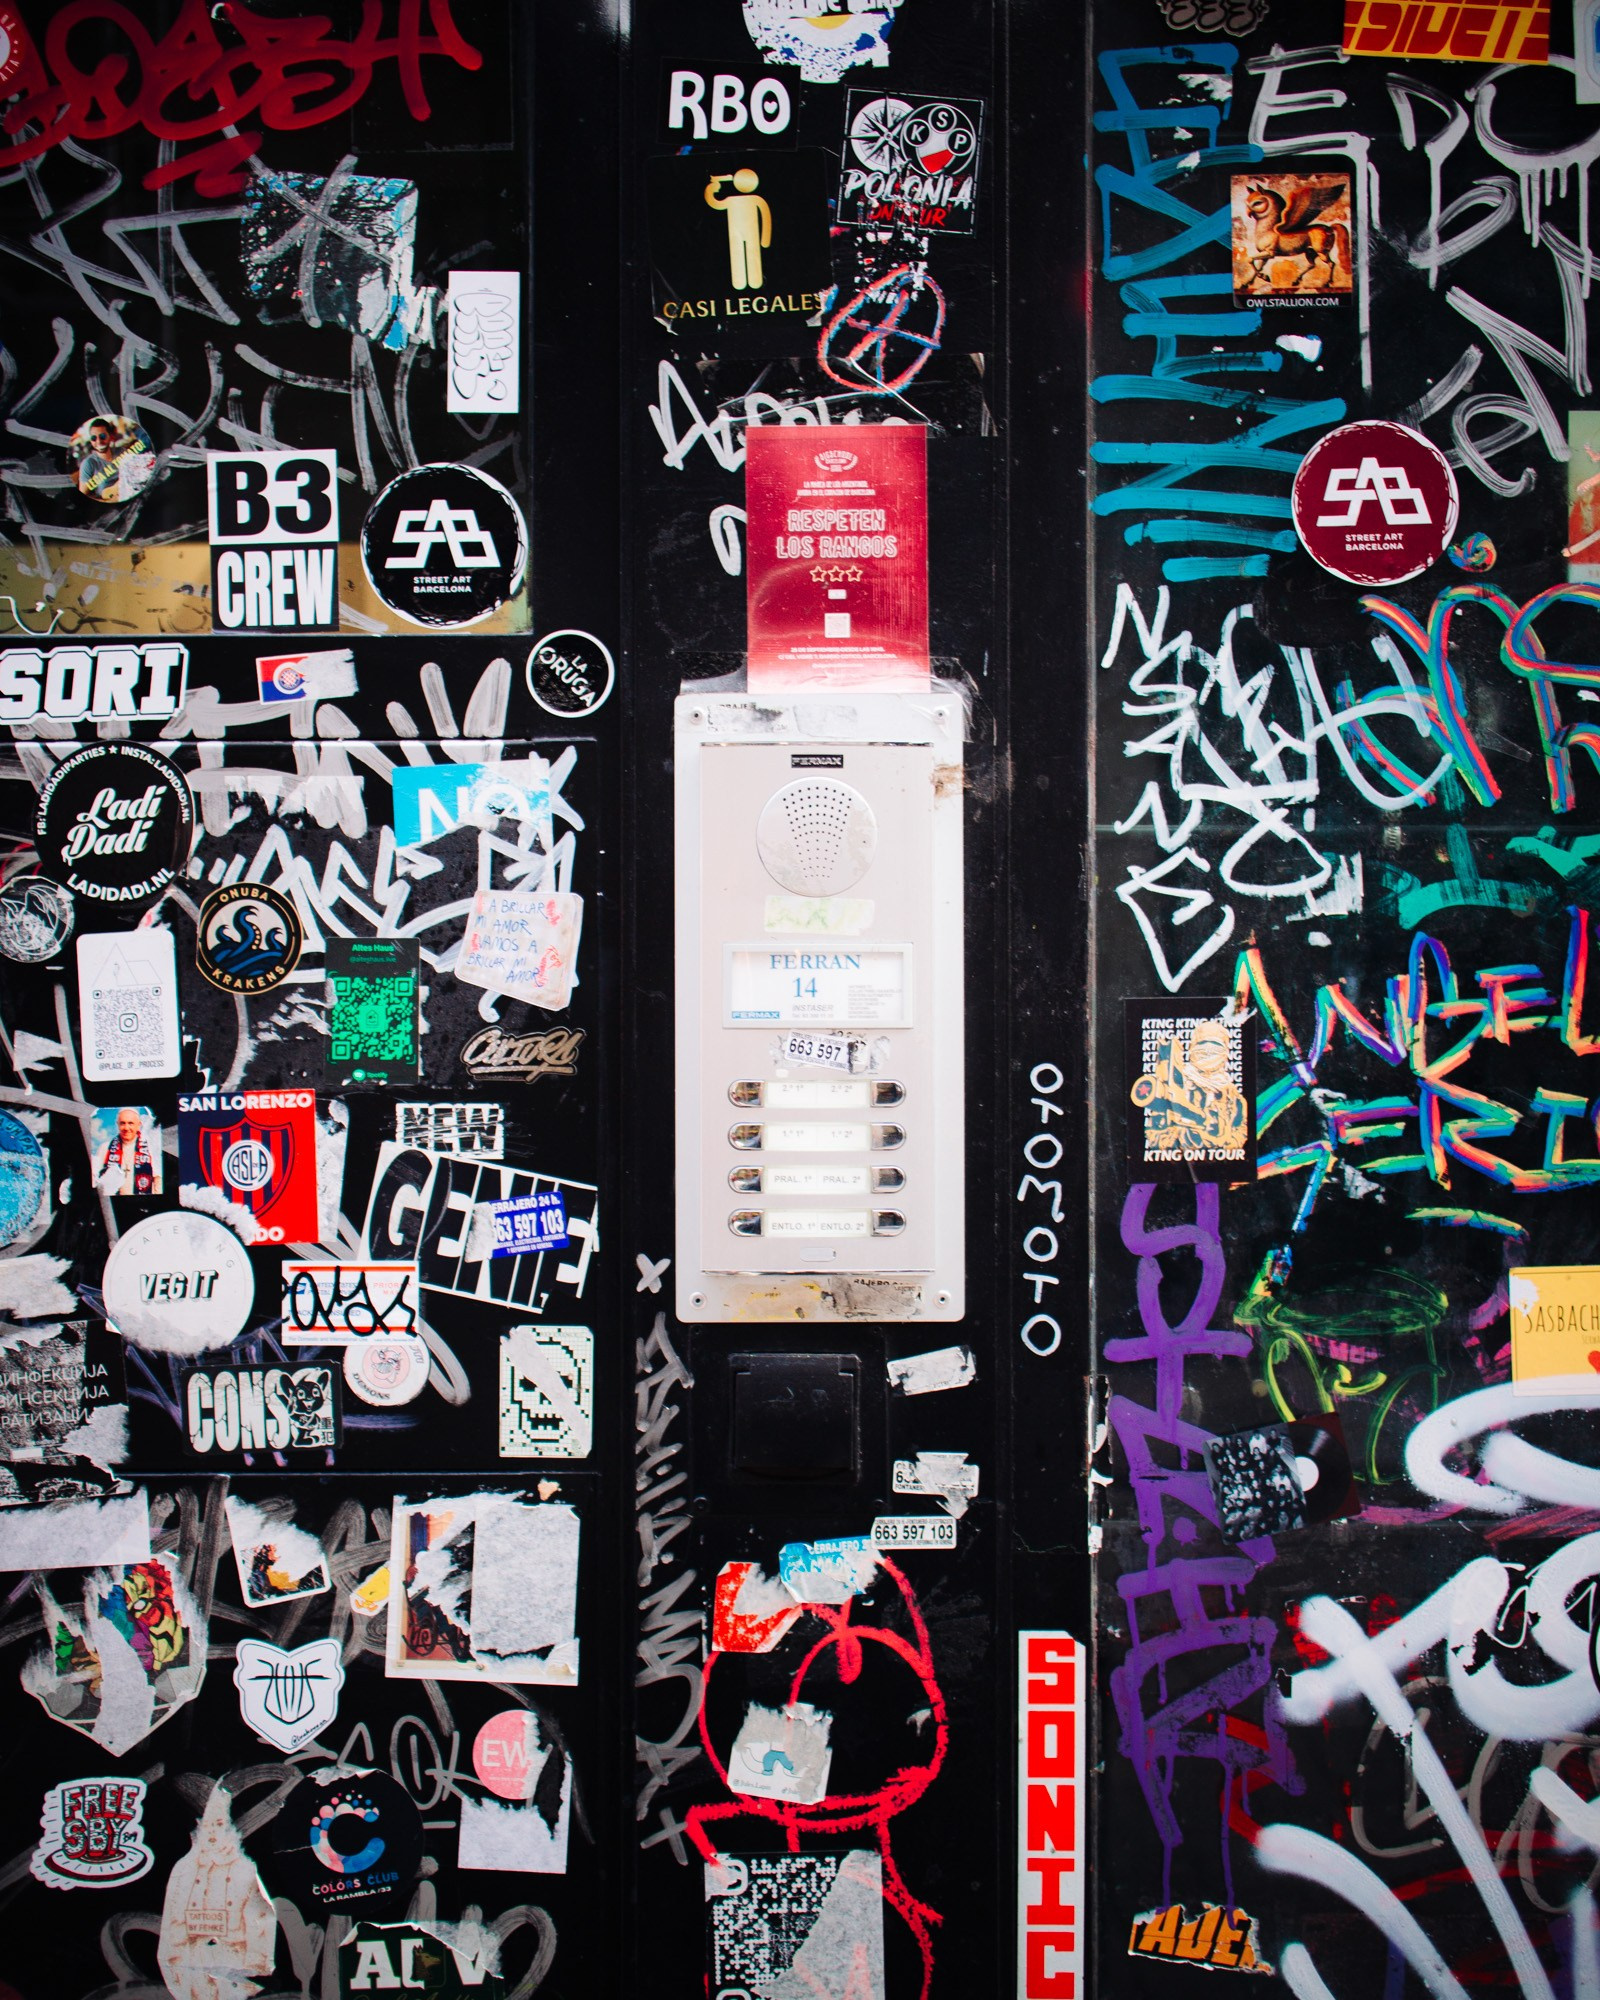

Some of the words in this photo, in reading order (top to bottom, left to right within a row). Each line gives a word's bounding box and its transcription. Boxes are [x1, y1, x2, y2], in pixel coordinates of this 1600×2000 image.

[668, 71, 790, 139] RBO
[842, 168, 973, 210] POLONIA
[663, 300, 716, 319] CASI
[726, 293, 823, 316] LEGALES
[1246, 298, 1339, 308] OWLSTALLION.COM
[215, 458, 332, 537] B3
[1316, 457, 1433, 527] SAB
[788, 509, 886, 532] RESPETEN
[384, 499, 501, 569] SAB
[1345, 533, 1381, 542] STREET
[1384, 533, 1404, 541] ART
[776, 535, 814, 559] LOS
[819, 535, 898, 559] RANGOS
[1345, 543, 1404, 551] BARCELONA
[217, 549, 334, 628] CREW
[413, 576, 449, 584] STREET
[451, 576, 472, 584] ART
[413, 585, 472, 594] BARCELONA
[571, 655, 588, 673] LA
[0, 648, 181, 719] SORI
[539, 646, 596, 707] ORUGA
[791, 757, 842, 766] FERMAX
[36, 746, 106, 816] LADIDADIPARTIES
[154, 759, 190, 823] LADIDADI.NL
[76, 785, 168, 830] Ladi
[60, 820, 154, 866] Dadi
[66, 867, 176, 901] LADIDADI.NL
[219, 887, 269, 903] ONUBA
[492, 918, 533, 936] AMOR
[352, 944, 373, 952] Altes
[373, 944, 395, 952] Haus
[527, 939, 538, 954] A
[769, 954, 862, 970] FERRAN
[212, 965, 285, 989] KRAKENS
[505, 969, 544, 988] AMOR
[792, 977, 818, 998] 14
[732, 1011, 780, 1019] FERMAX
[792, 1004, 834, 1012] INSTASER
[1142, 1018, 1174, 1029] KTNG
[789, 1038, 813, 1056] 663
[817, 1044, 842, 1061] 597
[366, 1072, 388, 1081] Spotify
[178, 1095, 217, 1113] SAN
[220, 1092, 313, 1110] LORENZO
[1143, 1151, 1182, 1162] KTNG
[1183, 1151, 1207, 1162] ON
[1208, 1149, 1246, 1161] TOUR
[774, 1175, 801, 1183] PRAL.
[822, 1175, 849, 1183] PRAL.
[491, 1197, 538, 1215] ERRAJERO
[538, 1194, 551, 1208] 24
[514, 1212, 538, 1239] 597
[540, 1208, 565, 1235] 103
[771, 1222, 804, 1231] ENTLO.
[820, 1222, 854, 1231] ENTLO.
[128, 1225, 236, 1270] CATENG
[140, 1272, 188, 1305] VEG
[189, 1269, 220, 1300] IT
[353, 1372, 391, 1400] DEMONS
[1, 1407, 91, 1429] РАТИЗАЦИ
[188, 1369, 291, 1453] CONS
[875, 1525, 898, 1540] 663
[902, 1525, 926, 1540] 597
[930, 1525, 954, 1540] 103
[62, 1784, 141, 1821] FREE
[1028, 1637, 1076, 2000] SONIC
[62, 1817, 129, 1859] SBY
[311, 1878, 362, 1896] COLORS
[367, 1871, 399, 1886] CLUB
[323, 1896, 336, 1904] LA
[336, 1890, 377, 1901] RAMBLA
